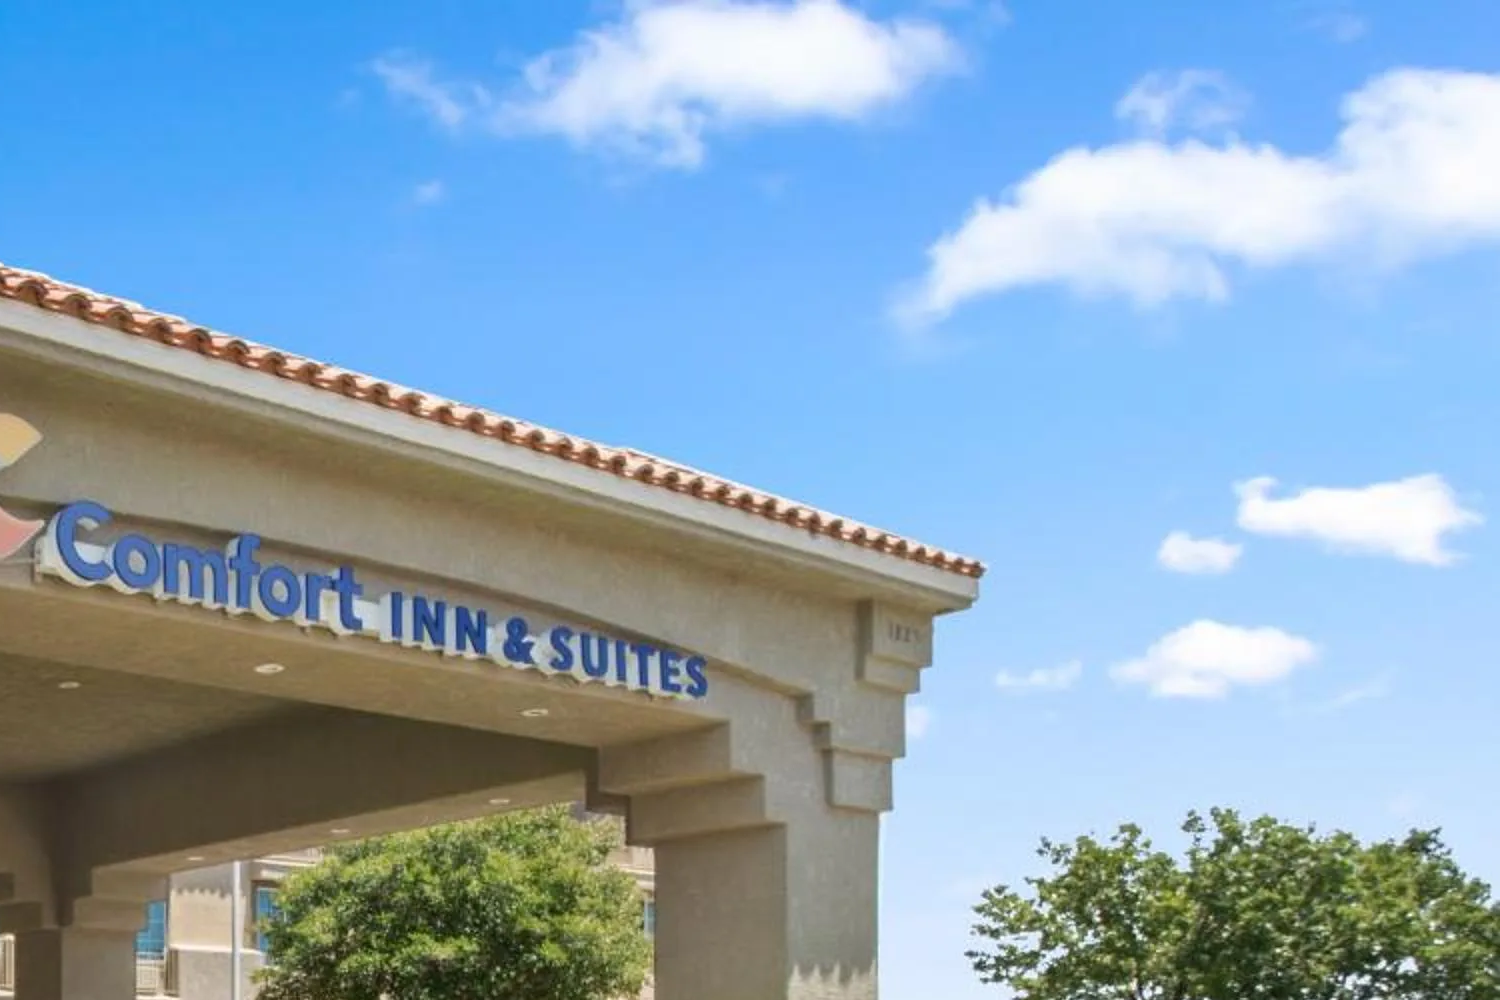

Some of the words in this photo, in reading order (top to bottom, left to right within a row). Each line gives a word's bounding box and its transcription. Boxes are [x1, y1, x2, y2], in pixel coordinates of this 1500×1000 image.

[55, 500, 363, 631] Comfort
[390, 591, 488, 655] INN
[503, 617, 534, 664] &
[550, 625, 709, 698] SUITES
